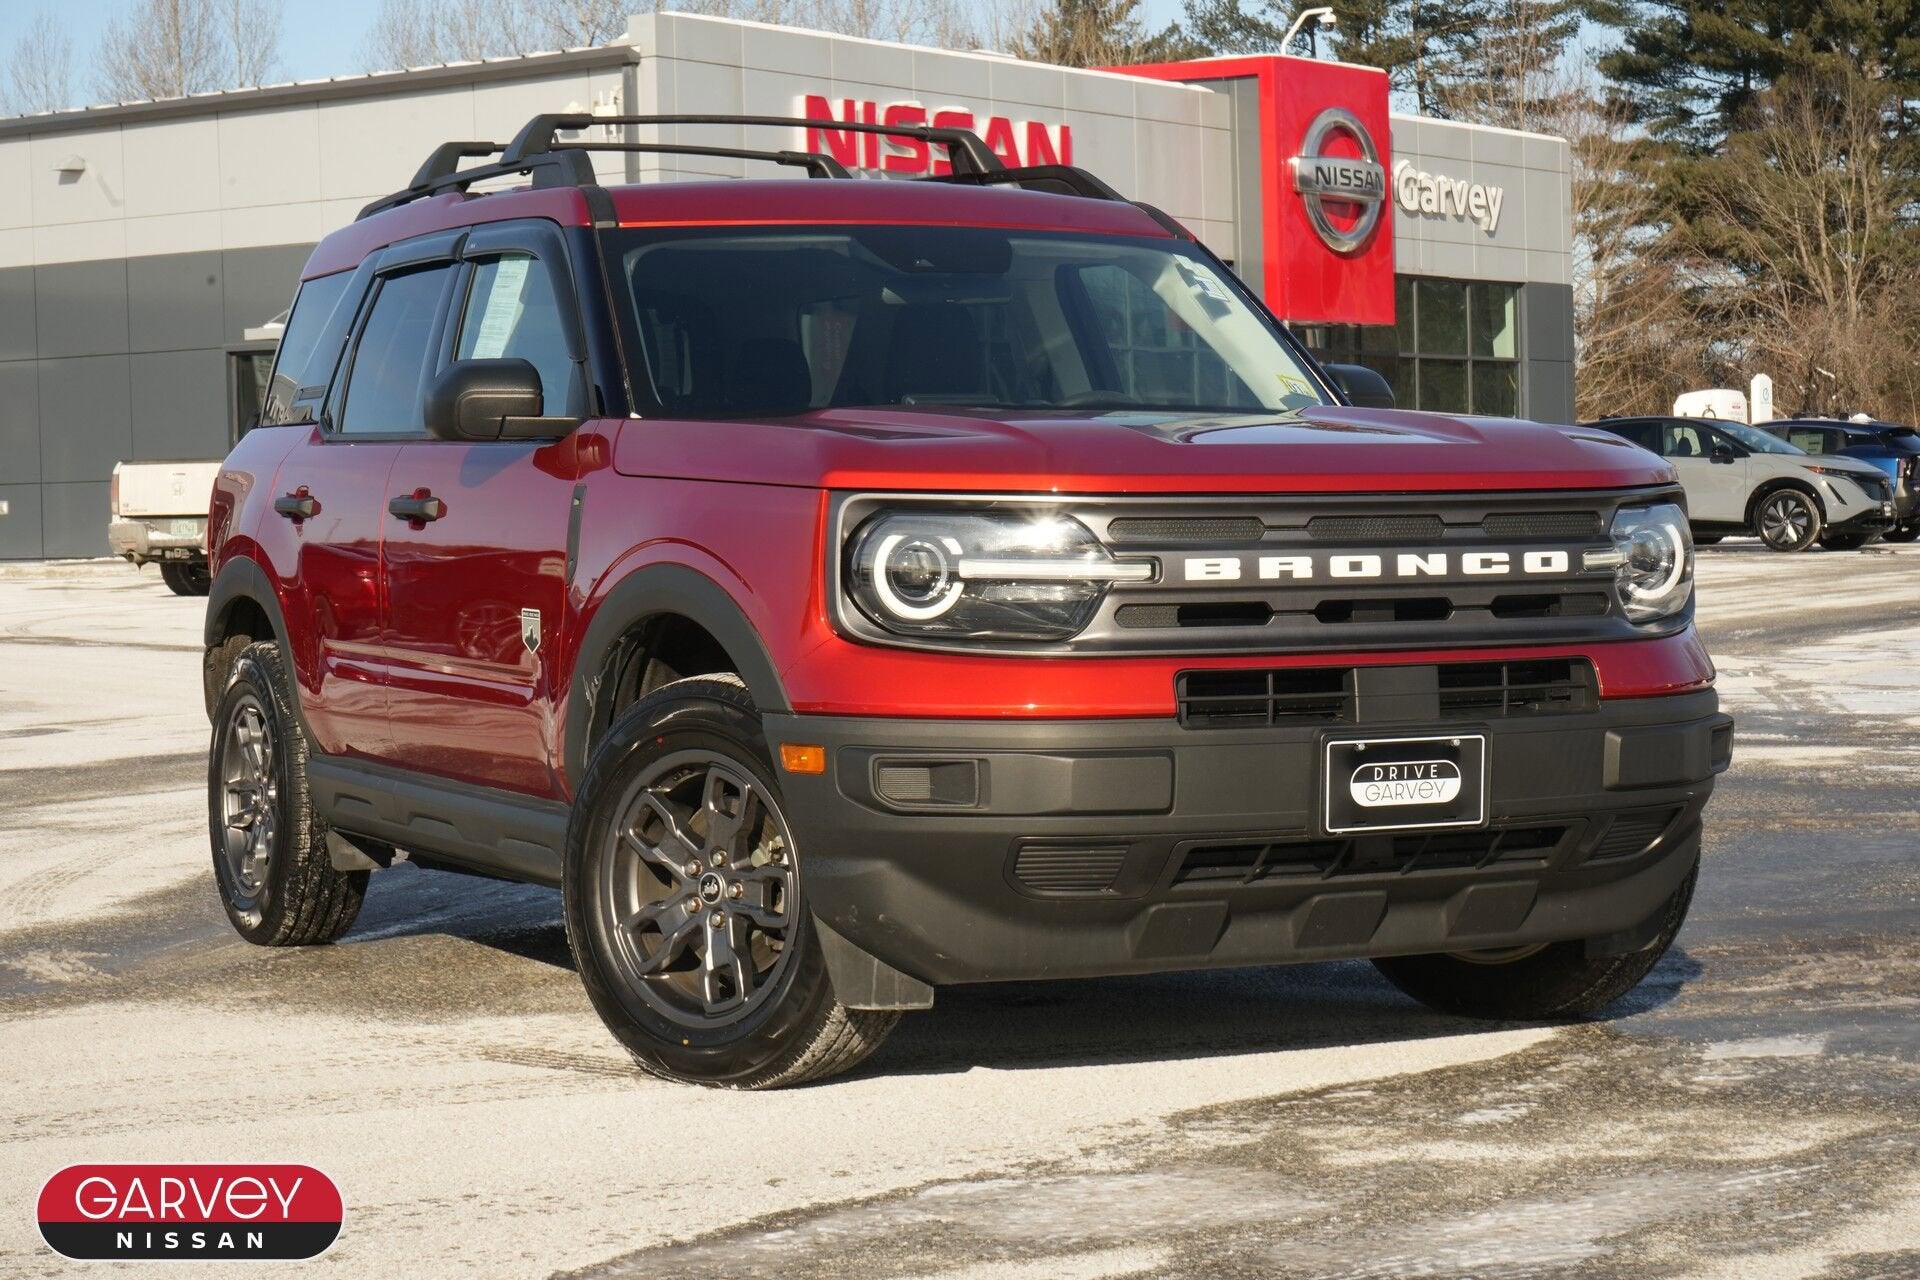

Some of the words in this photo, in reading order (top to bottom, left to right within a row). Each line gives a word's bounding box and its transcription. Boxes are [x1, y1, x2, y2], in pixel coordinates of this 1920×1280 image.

[1315, 165, 1384, 193] NISSAN
[1397, 163, 1504, 232] Garvey
[1184, 551, 1569, 582] BRONCO
[1374, 764, 1438, 781] DRIVE
